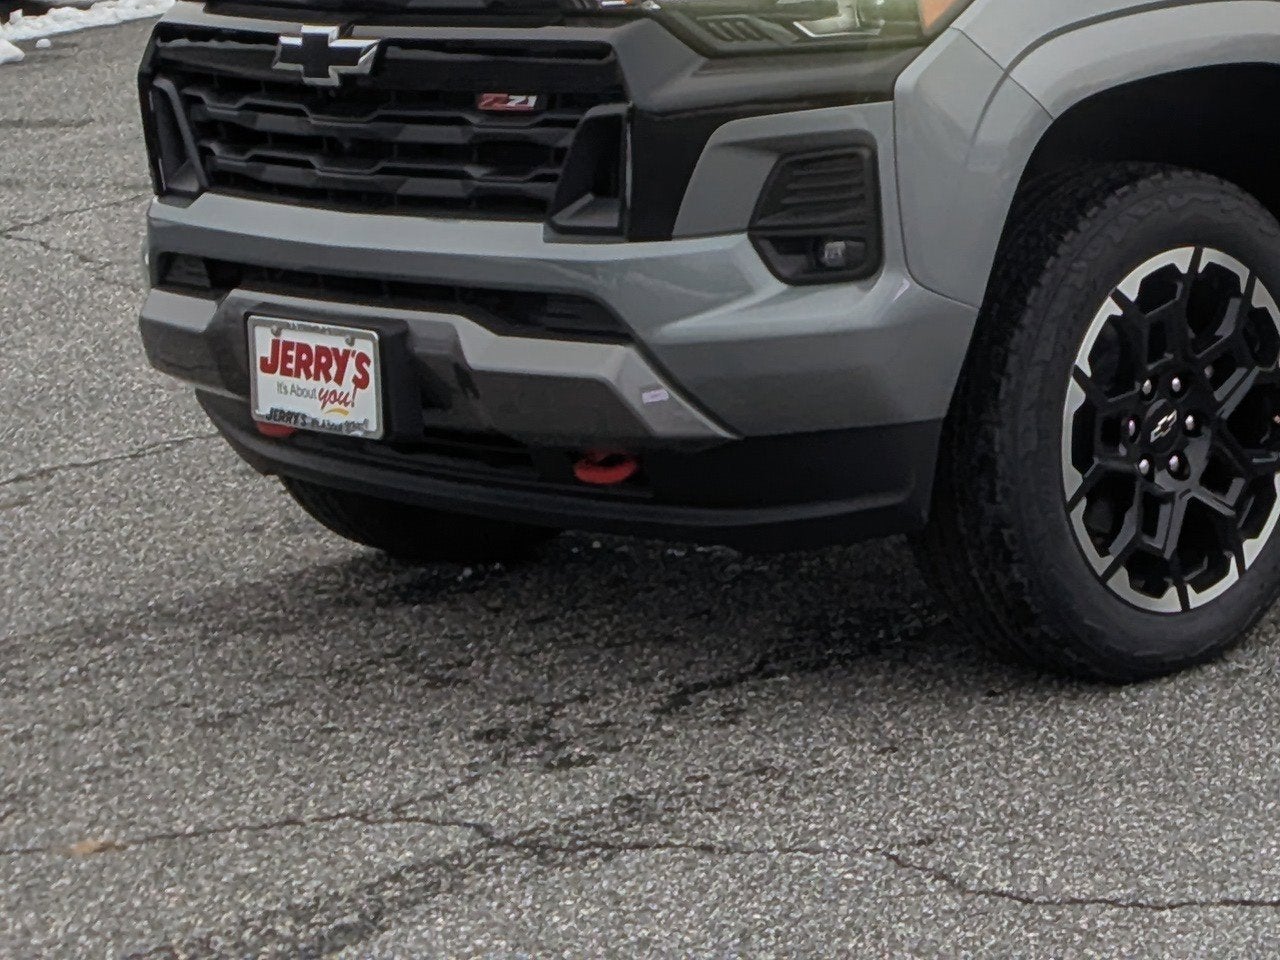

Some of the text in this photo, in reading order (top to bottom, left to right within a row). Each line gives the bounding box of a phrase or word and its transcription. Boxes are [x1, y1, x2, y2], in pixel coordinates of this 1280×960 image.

[479, 93, 538, 110] Z71
[260, 338, 371, 390] JERRY'S
[276, 381, 358, 409] It's About you!
